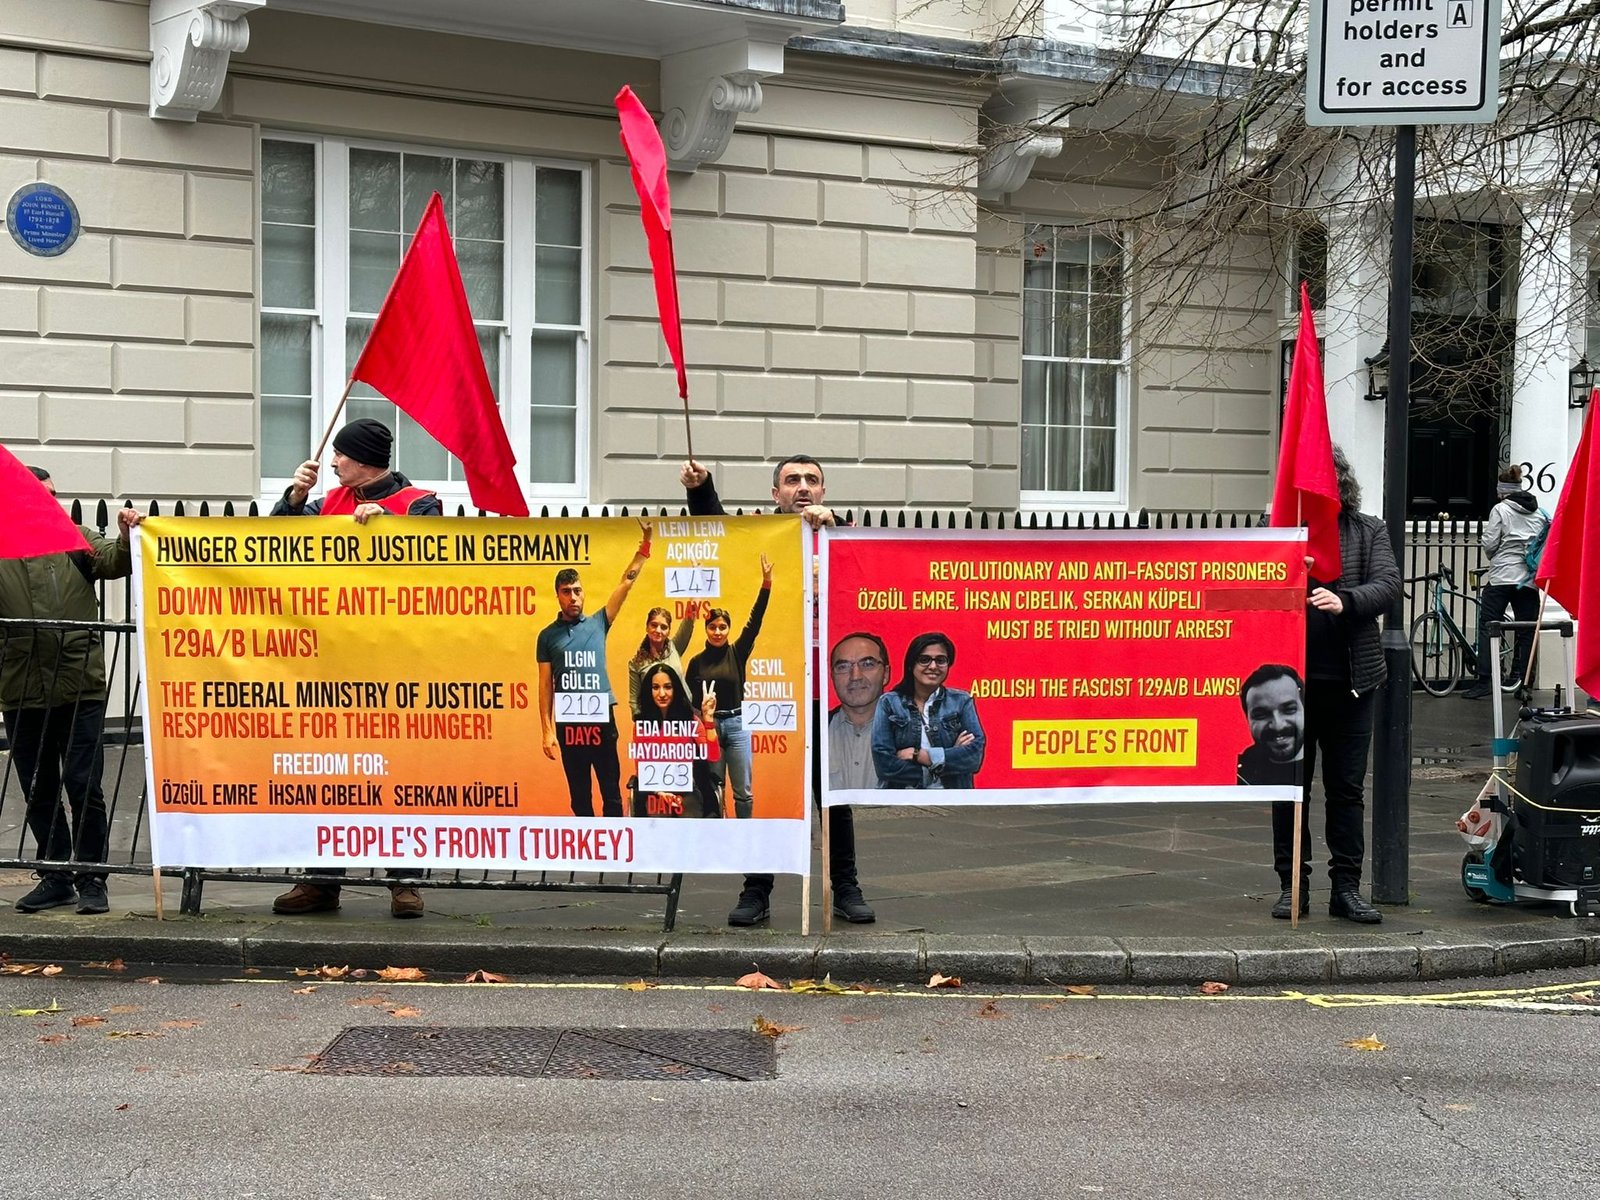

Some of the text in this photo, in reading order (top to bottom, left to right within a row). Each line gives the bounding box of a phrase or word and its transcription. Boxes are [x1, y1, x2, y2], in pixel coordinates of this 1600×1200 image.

[1350, 0, 1433, 16] permit
[1452, 3, 1467, 26] A
[1344, 20, 1438, 40] holders
[1380, 48, 1425, 68] and
[1336, 77, 1467, 96] for access
[1520, 462, 1556, 493] 36
[658, 521, 725, 537] ILENI LENA
[157, 534, 589, 563] HUNGER STRIKE FOR JUSTICE IN GERMANY!
[667, 540, 719, 561] AÇIKGÖZ
[670, 569, 716, 593] 147
[929, 561, 1287, 581] REVOLUTIONARY AND ANTI-FASCIST PRISONERS
[158, 586, 536, 616] DOWN WITH THE ANTI-DEMOCRATIC
[675, 601, 712, 620] DAYS
[858, 588, 1201, 612] ÖZGÜL EMRE, İHSAN CIBELIK, SERKAN KÜPELI
[987, 620, 1233, 640] MUST BE TRIED WITHOUT ARREST
[161, 628, 319, 657] 129A/B LAWS!
[564, 651, 596, 668] ILGIN
[751, 659, 785, 676] SEVIL
[561, 671, 600, 690] GÜLER
[743, 682, 793, 699] SEVIMLI
[970, 677, 1241, 698] ABOLISH THE FASCIST 129A/B LAWS!
[161, 681, 528, 709] THE FEDERAL MINISTRY OF JUSTICE IS
[561, 694, 604, 716] 212
[747, 704, 795, 726] 207
[163, 712, 492, 740] RESPONSIBLE FOR THEIR HUNGER!
[565, 726, 602, 746] DAYS
[636, 720, 699, 738] EDA DENIZ
[628, 743, 708, 760] HAYDAROGLU
[751, 735, 787, 754] DAYS
[1022, 729, 1189, 755] PEOPLE'S FRONT
[273, 753, 389, 776] FREEDOM FOR:
[644, 764, 689, 786] 263
[162, 779, 519, 808] ÖZGÜL EMRE İHSAN CIBELİK SERKAN KÜPELİ
[648, 795, 684, 815] DAYS
[317, 825, 634, 862] PEOPLE'S FRONT (TURKEY)
